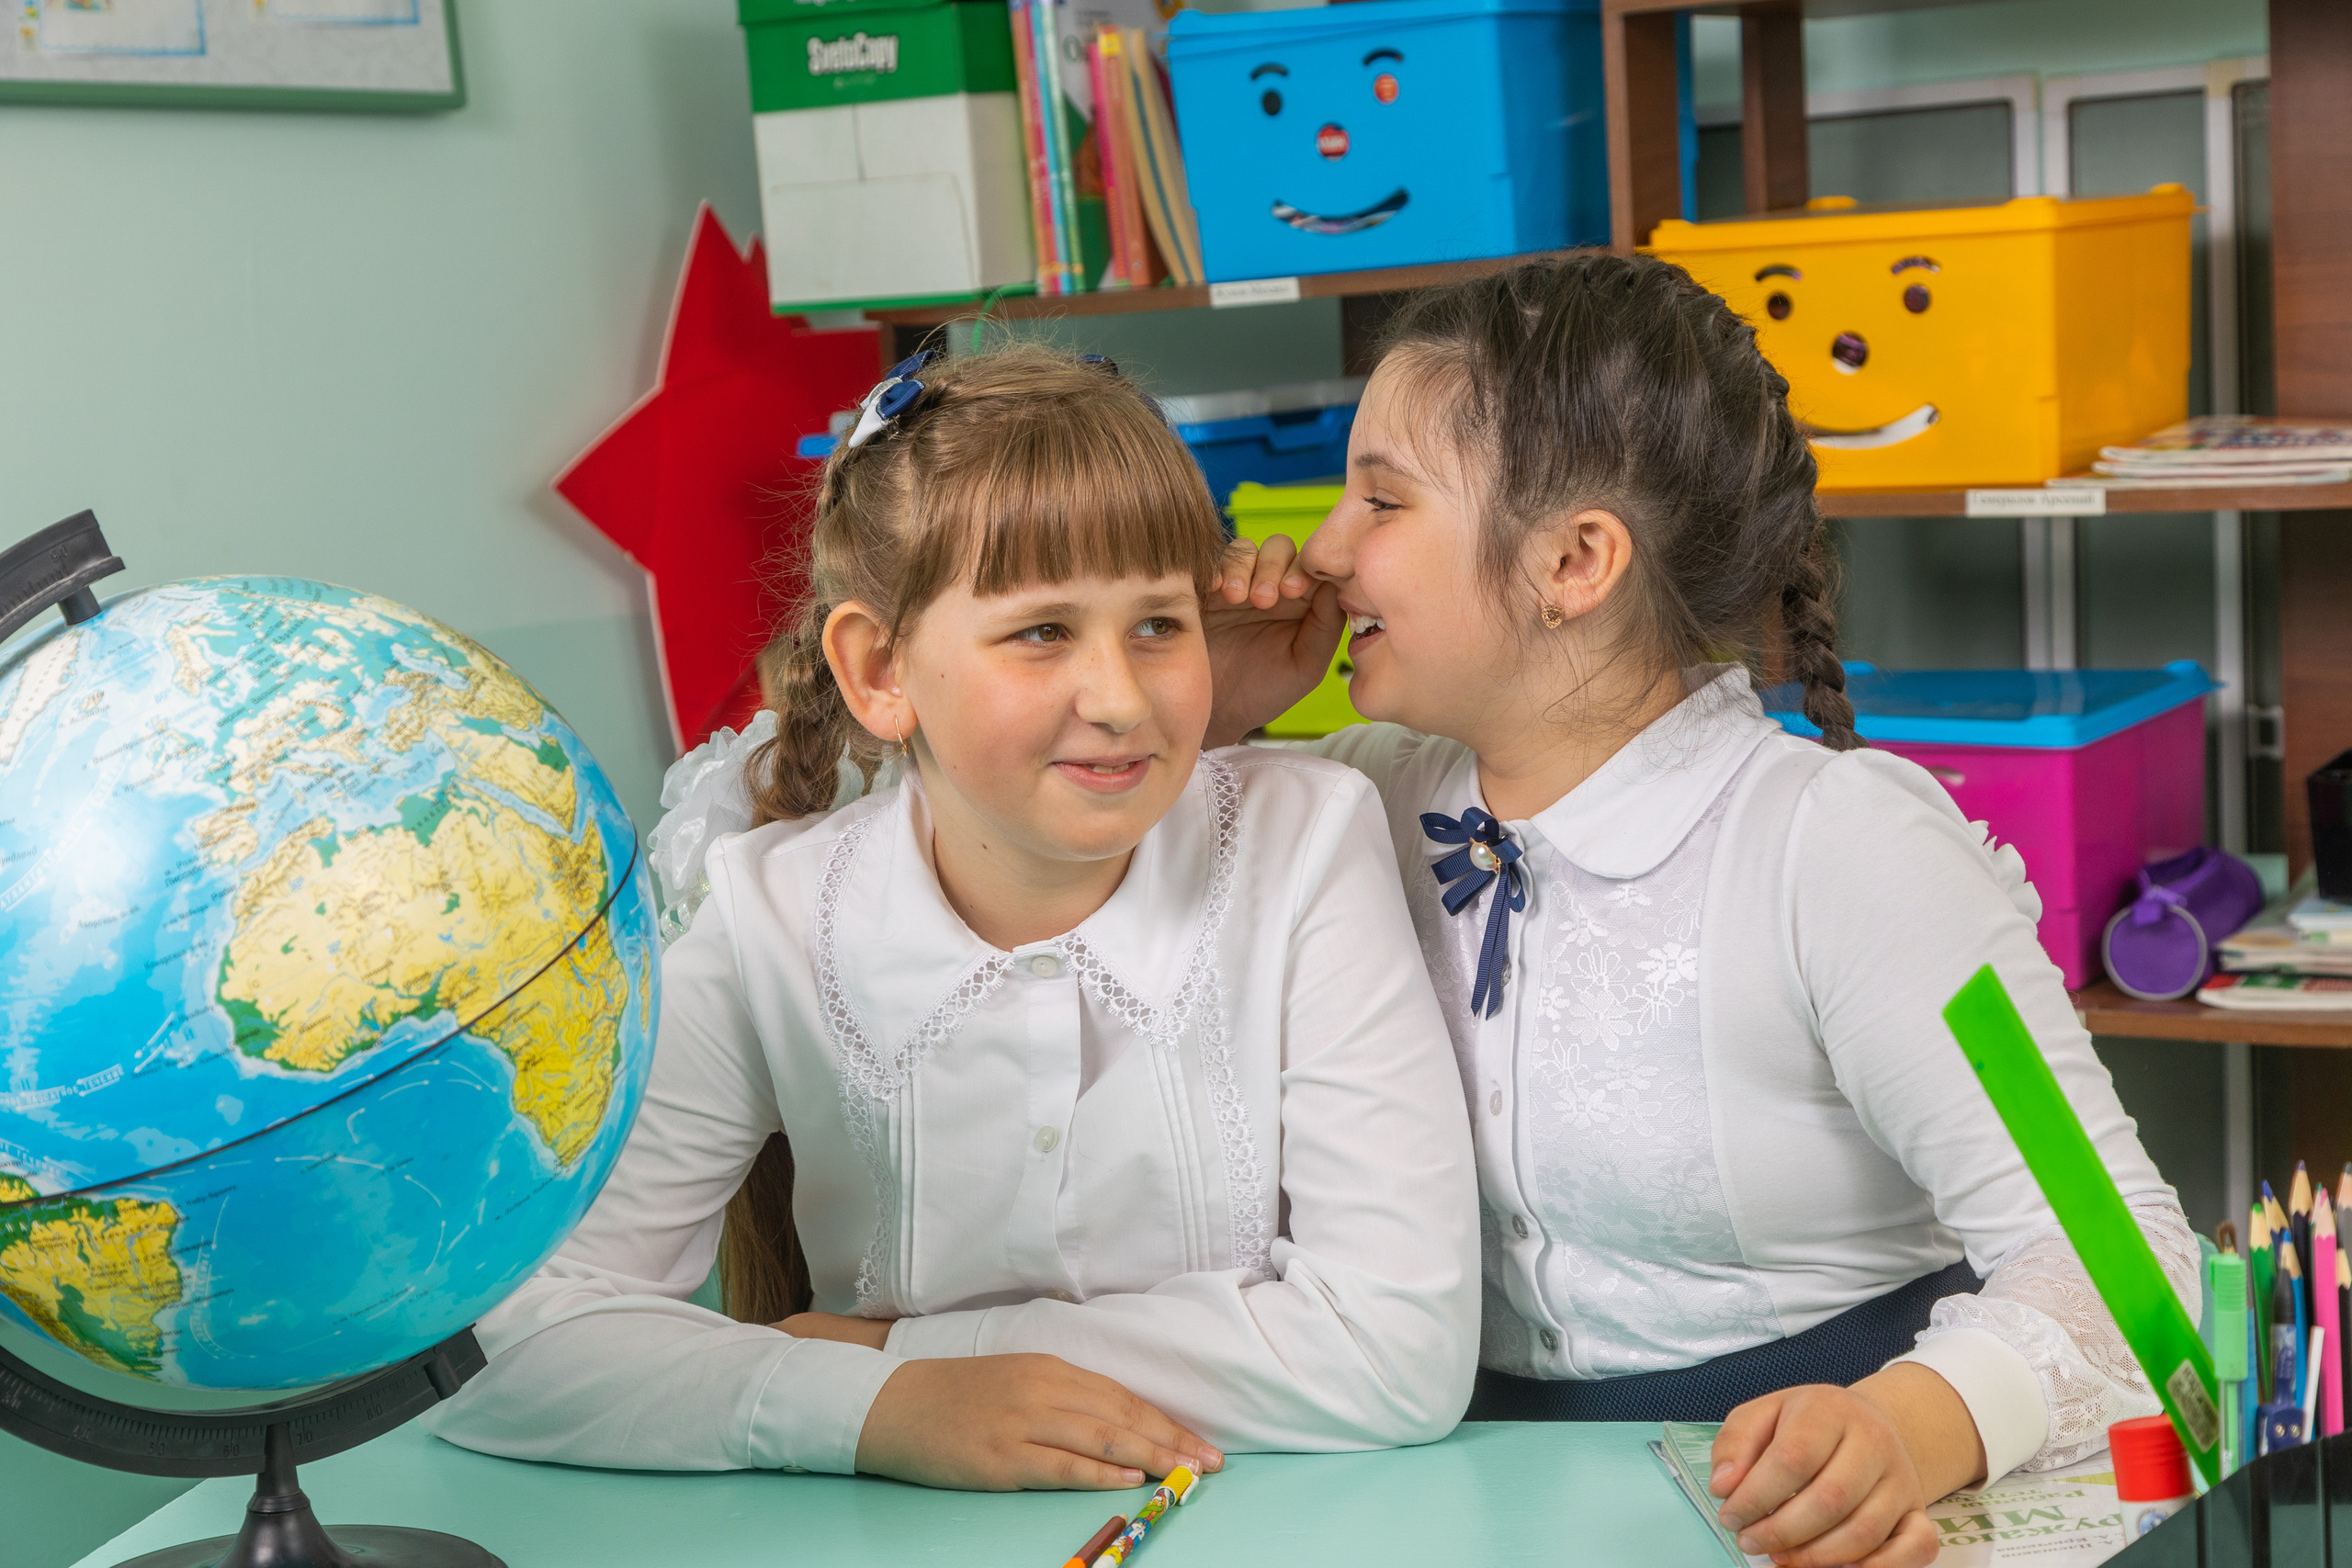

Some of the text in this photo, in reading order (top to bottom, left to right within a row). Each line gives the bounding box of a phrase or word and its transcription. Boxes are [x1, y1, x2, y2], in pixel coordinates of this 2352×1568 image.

[808, 31, 899, 76] SvetoCopy
[69, 705, 110, 725] Исландия
[122, 770, 165, 794] Ирландия
[366, 1403, 383, 1421] 80
[296, 1430, 313, 1446] 70
[147, 1442, 165, 1456] 50
[222, 1443, 240, 1458] 60
[1960, 1489, 2087, 1509] Рабочая
[1931, 1504, 2075, 1535] МИ
[1939, 1512, 2123, 1548] ружаю
[1996, 1535, 2088, 1553] Крючкова
[2000, 1541, 2094, 1559] Плешаков
